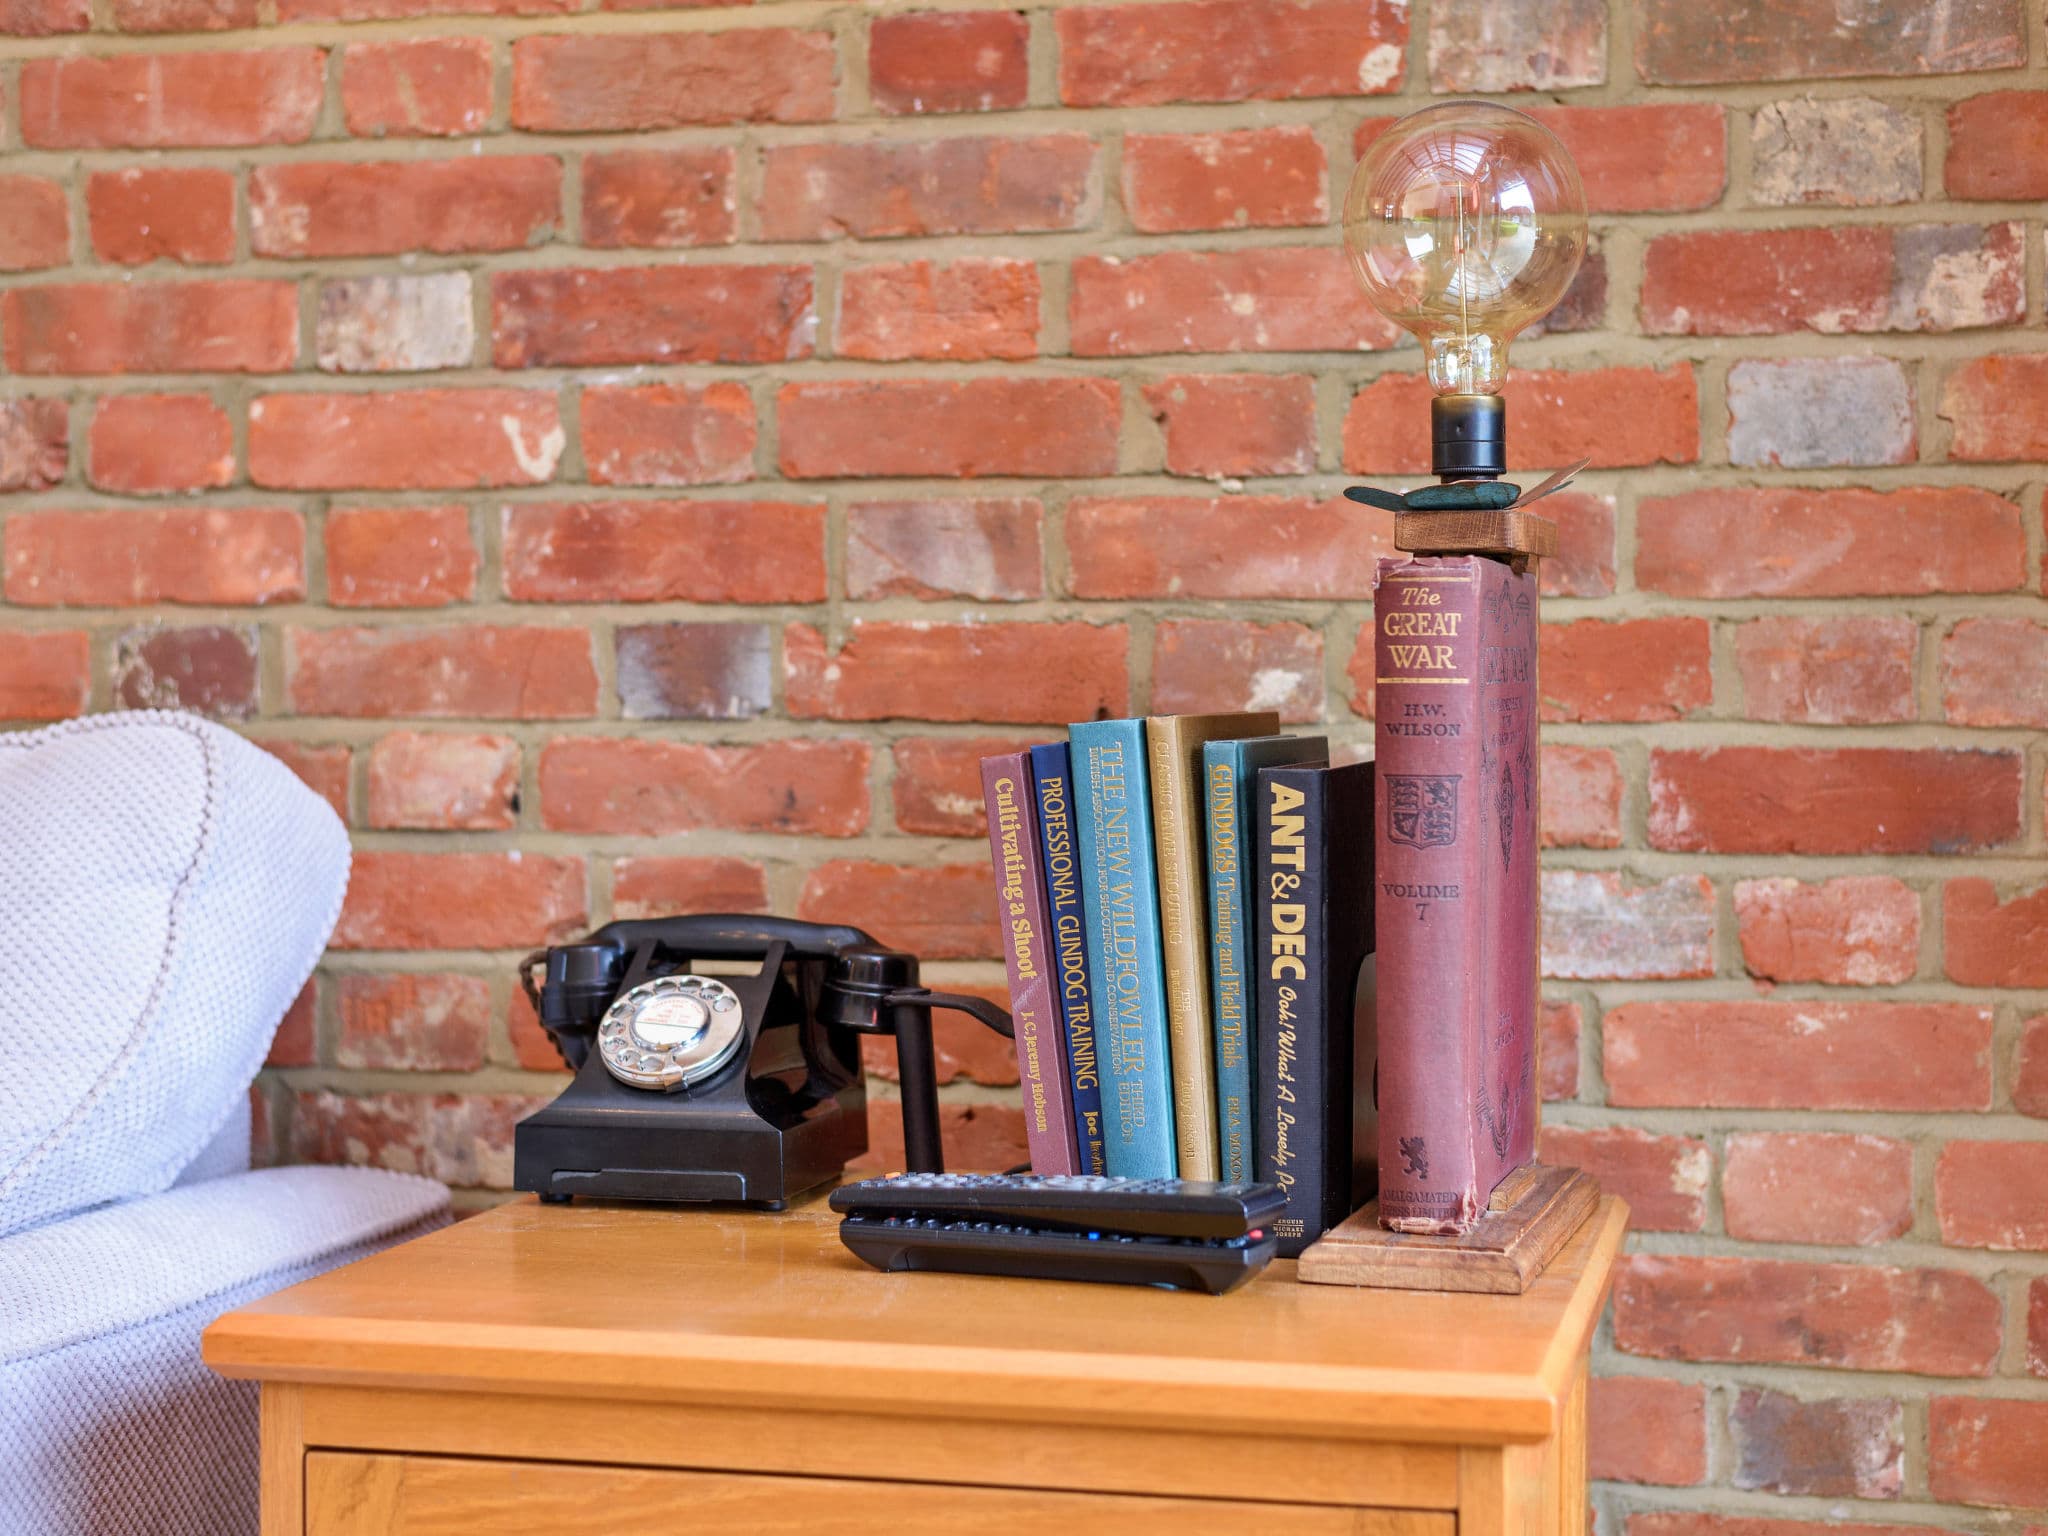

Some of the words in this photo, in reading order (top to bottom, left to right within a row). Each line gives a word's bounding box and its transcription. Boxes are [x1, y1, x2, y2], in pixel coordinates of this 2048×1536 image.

[1401, 587, 1442, 606] The
[1383, 612, 1462, 636] GREAT
[1387, 645, 1457, 669] WAR
[1385, 722, 1461, 738] WILSON
[1403, 703, 1446, 718] H.W.
[1100, 740, 1127, 801] THE
[994, 777, 1027, 901] Cultivating
[1040, 775, 1076, 912] PROFESSIONAL
[1104, 805, 1132, 876] NEW
[1213, 763, 1238, 874] GUNDOGS
[1271, 781, 1305, 872] ANT
[1009, 901, 1026, 916] a
[1215, 875, 1238, 946] Training
[1271, 871, 1300, 900] &
[1382, 883, 1460, 899] VOLUME
[1415, 902, 1430, 921] 7
[1011, 918, 1038, 981] Shoot
[1057, 914, 1087, 1000] GUNDOG
[1218, 946, 1240, 977] and
[1271, 903, 1306, 981] DEC
[1111, 882, 1145, 1076] WILDFOWLER
[1220, 979, 1241, 1020] Field
[1067, 1001, 1098, 1091] TRAINING
[1221, 1021, 1243, 1069] Trials
[1277, 1028, 1297, 1085] What
[1277, 1082, 1296, 1103] A
[1082, 1111, 1099, 1136] Joe
[1271, 1105, 1296, 1167] Lovely
